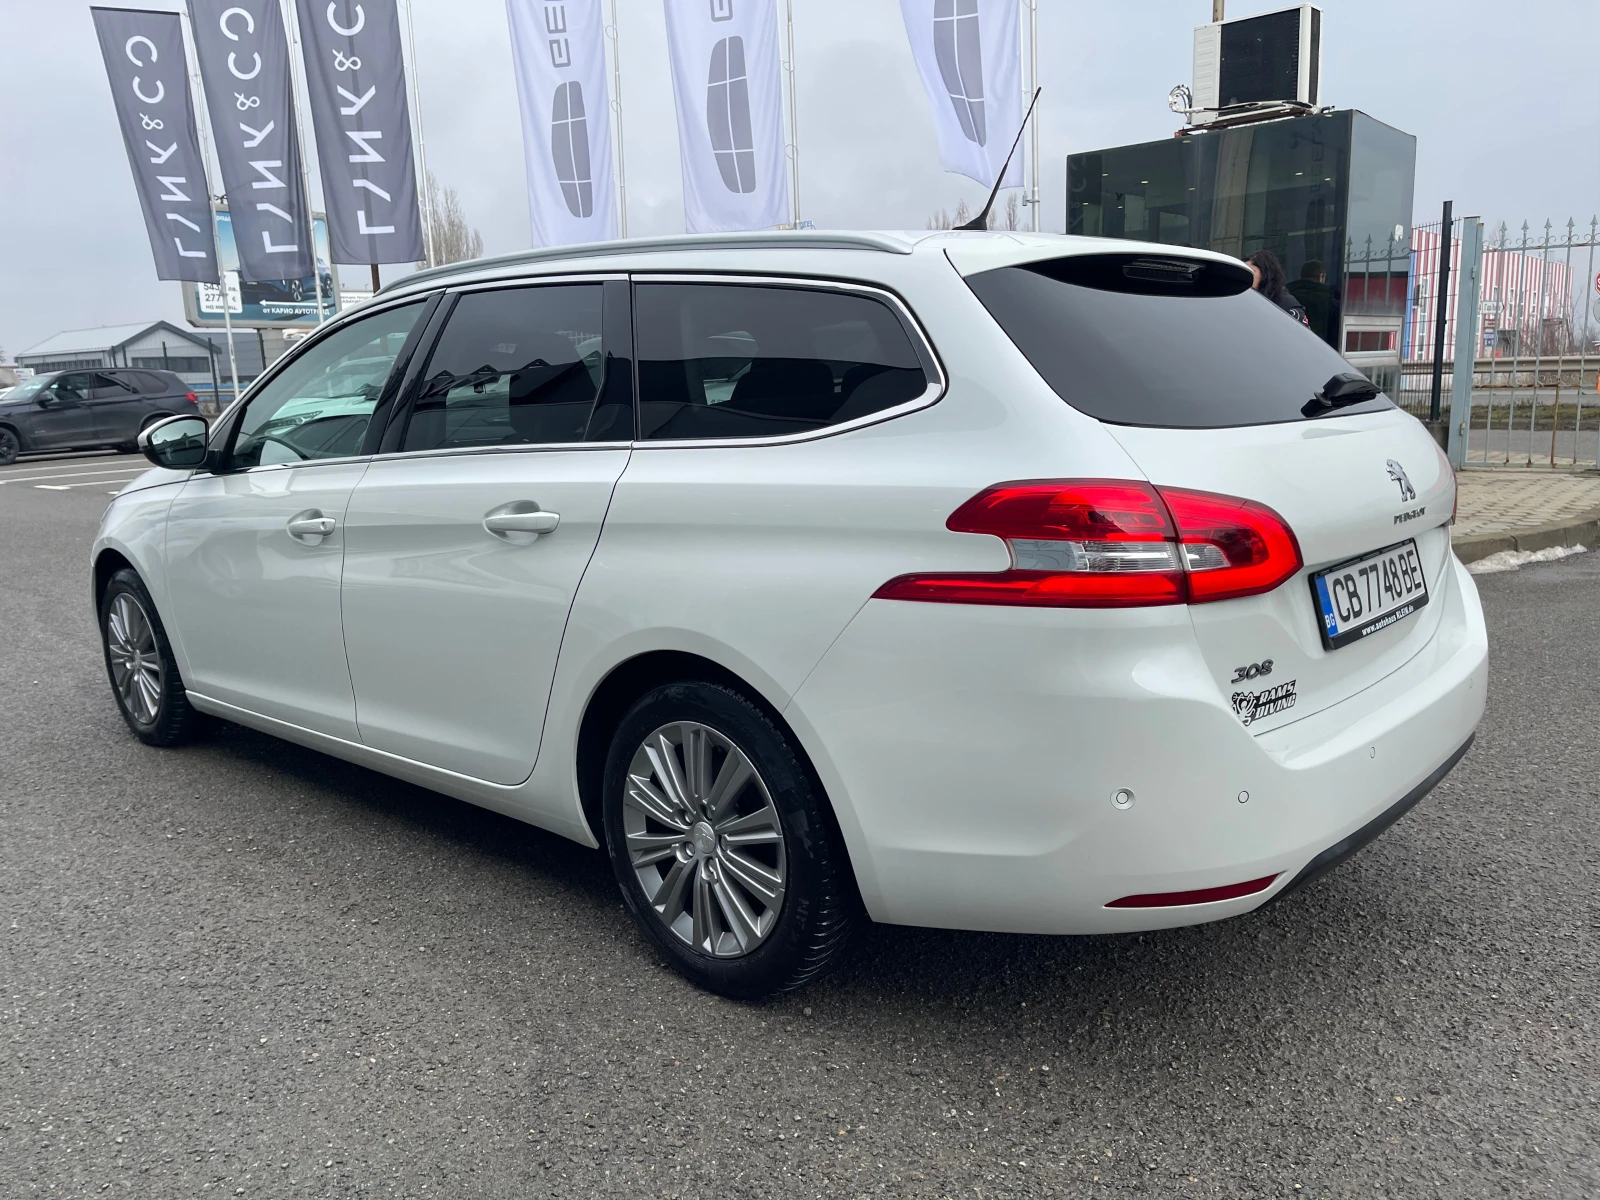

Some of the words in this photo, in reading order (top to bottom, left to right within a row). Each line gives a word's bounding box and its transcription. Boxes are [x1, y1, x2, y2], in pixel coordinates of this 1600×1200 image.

[1325, 613, 1335, 628] BG
[1231, 659, 1274, 684] 308
[1258, 681, 1296, 705] RAMS
[1254, 695, 1296, 720] DIVING
